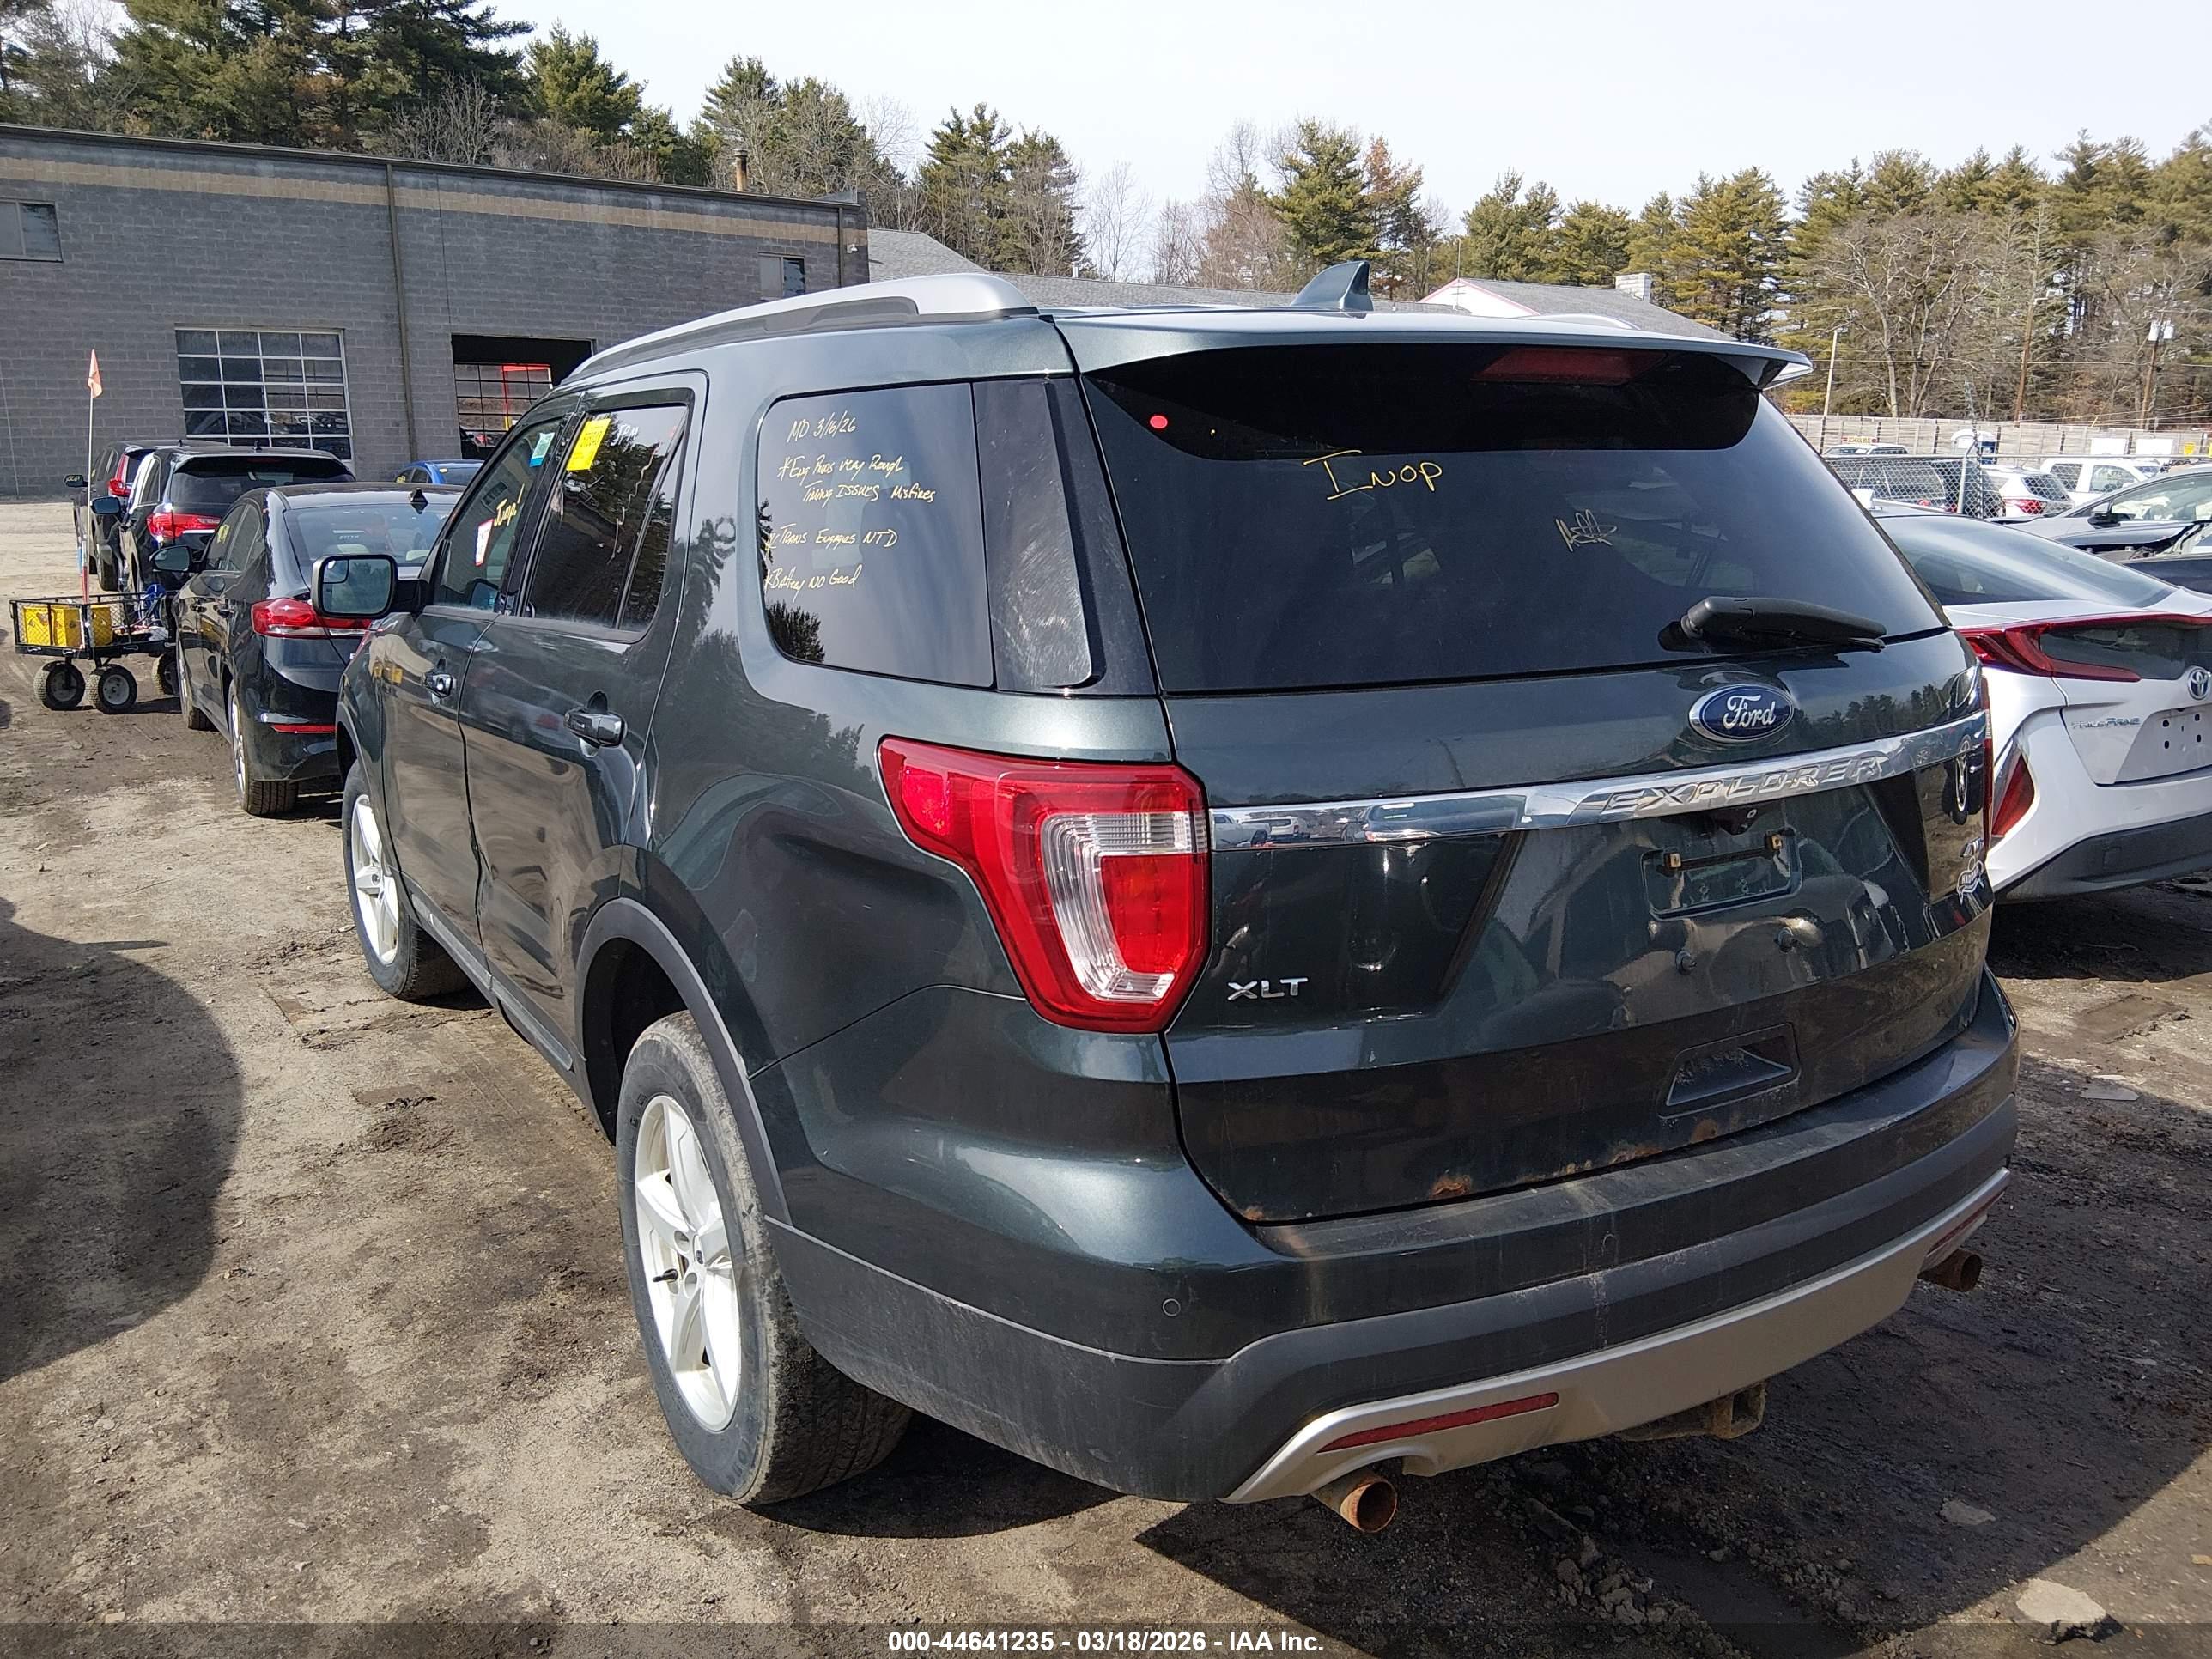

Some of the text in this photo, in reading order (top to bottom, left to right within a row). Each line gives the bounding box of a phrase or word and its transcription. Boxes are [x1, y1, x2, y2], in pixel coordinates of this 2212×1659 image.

[1723, 694, 1777, 730] Ford
[1600, 751, 1889, 816] EXPLORER
[1227, 977, 1309, 1000] XLT
